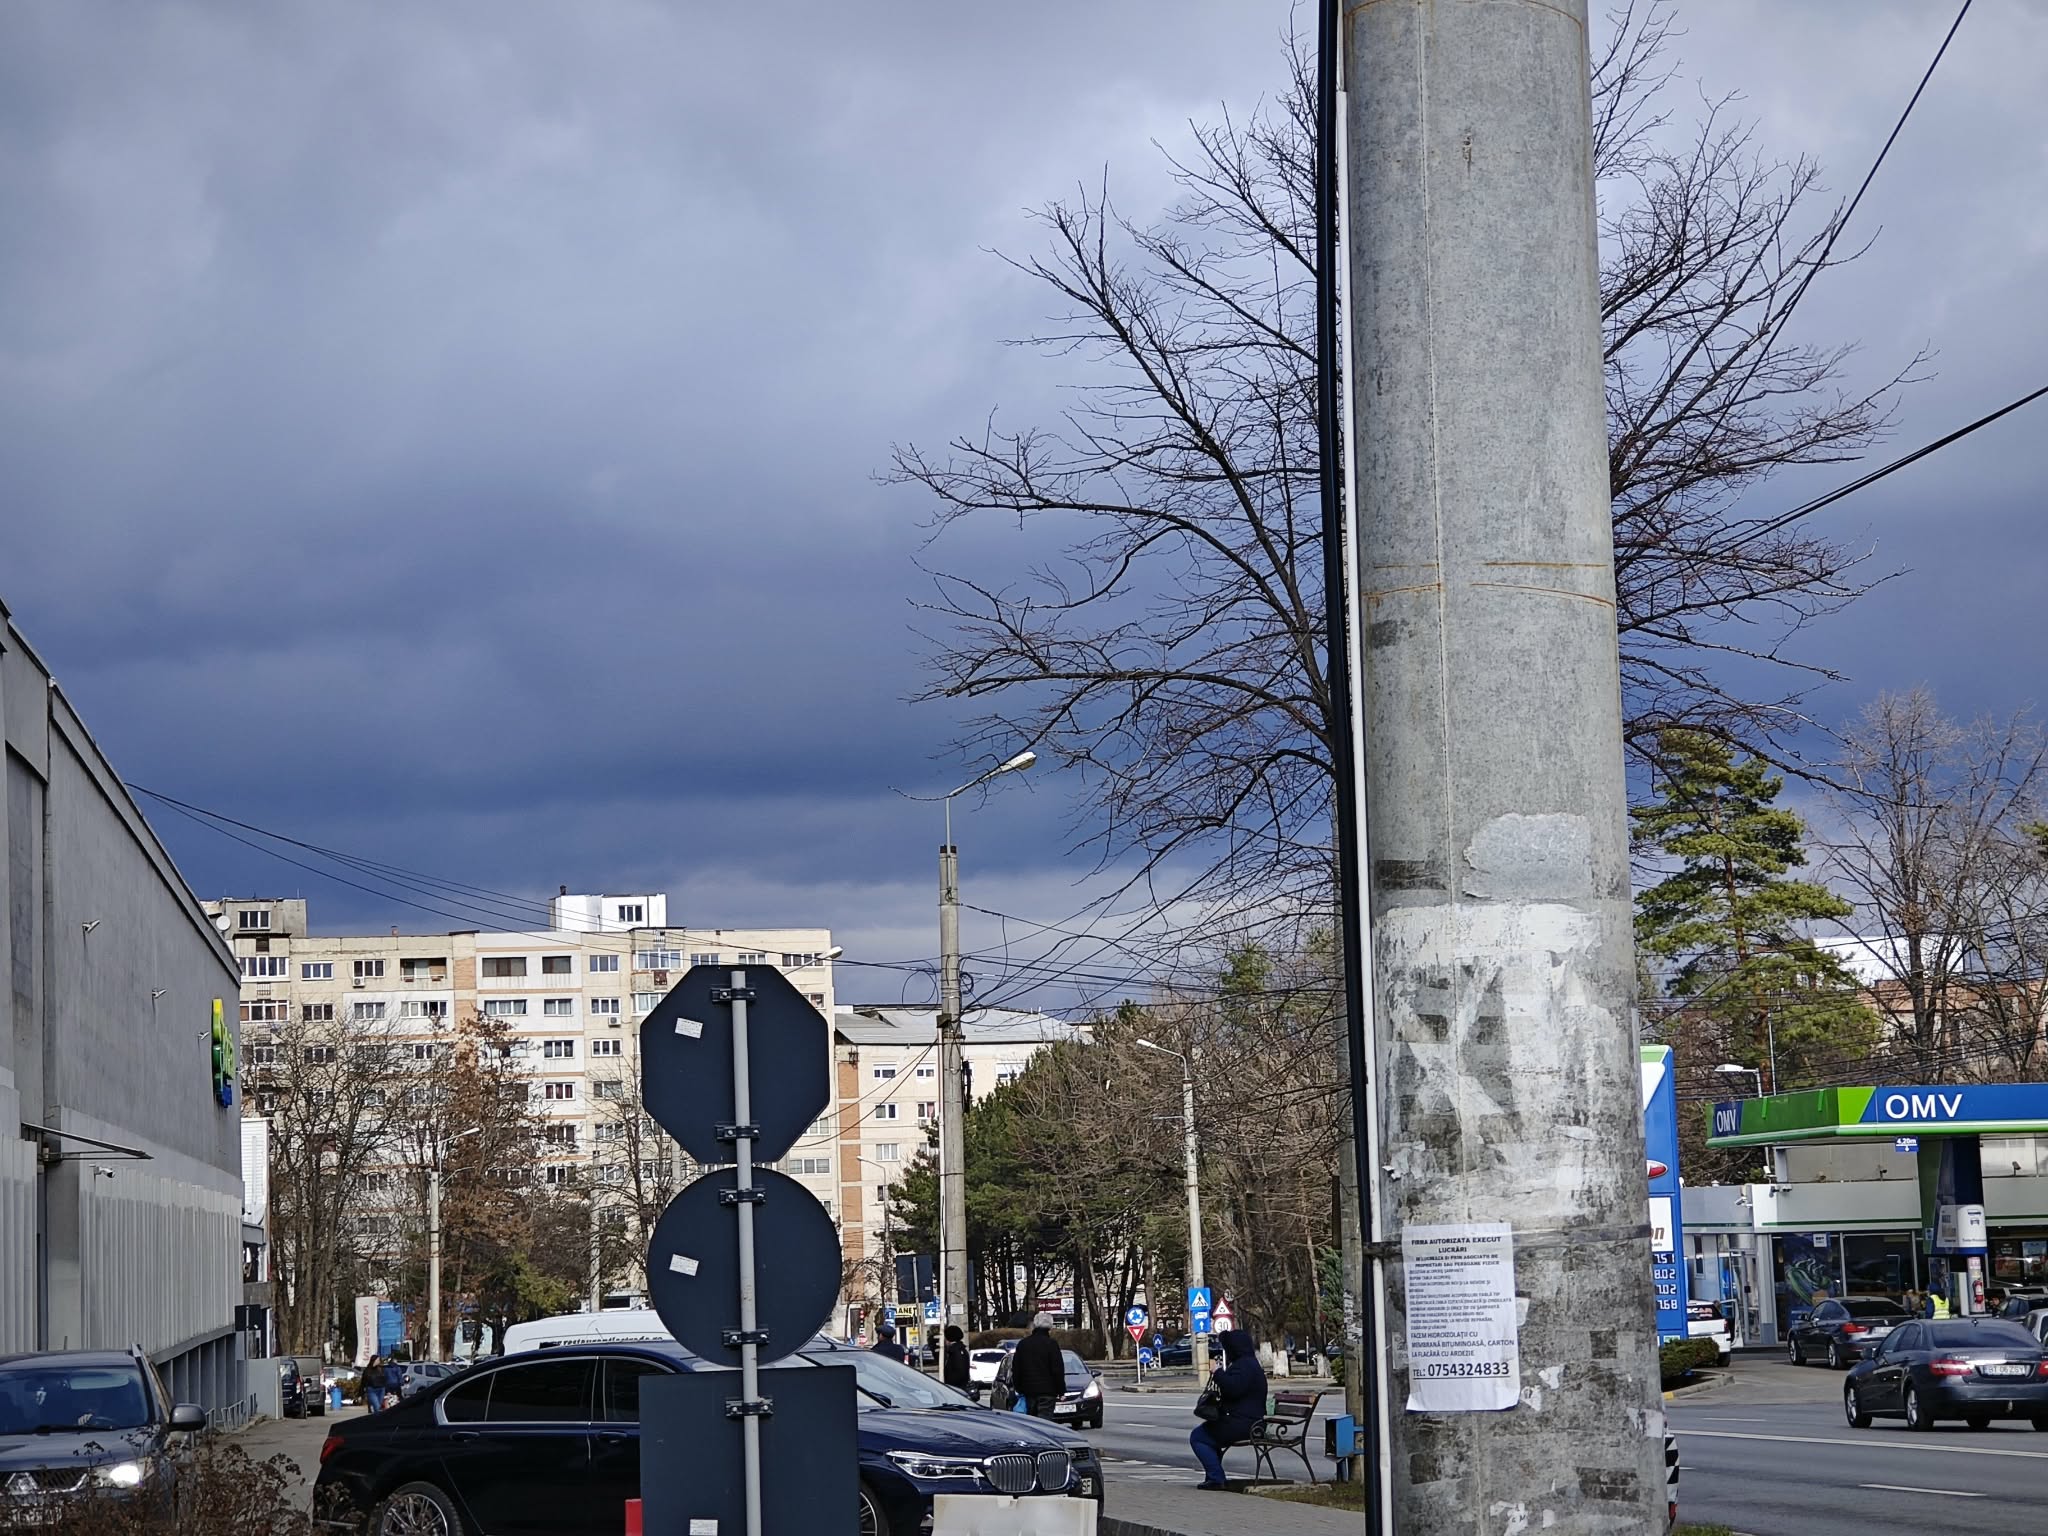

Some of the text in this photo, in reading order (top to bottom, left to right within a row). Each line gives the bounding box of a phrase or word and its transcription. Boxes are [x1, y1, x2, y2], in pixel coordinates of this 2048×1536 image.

[1885, 1093, 1964, 1120] OMV
[1716, 1108, 1736, 1132] OMV
[1472, 1236, 1502, 1244] EXECUT
[1654, 1269, 1676, 1279] 8.02
[1656, 1284, 1676, 1294] 7.02
[1658, 1299, 1677, 1310] 7.68
[1218, 1322, 1228, 1331] 30
[1413, 1362, 1509, 1377] TEL: 0754324833
